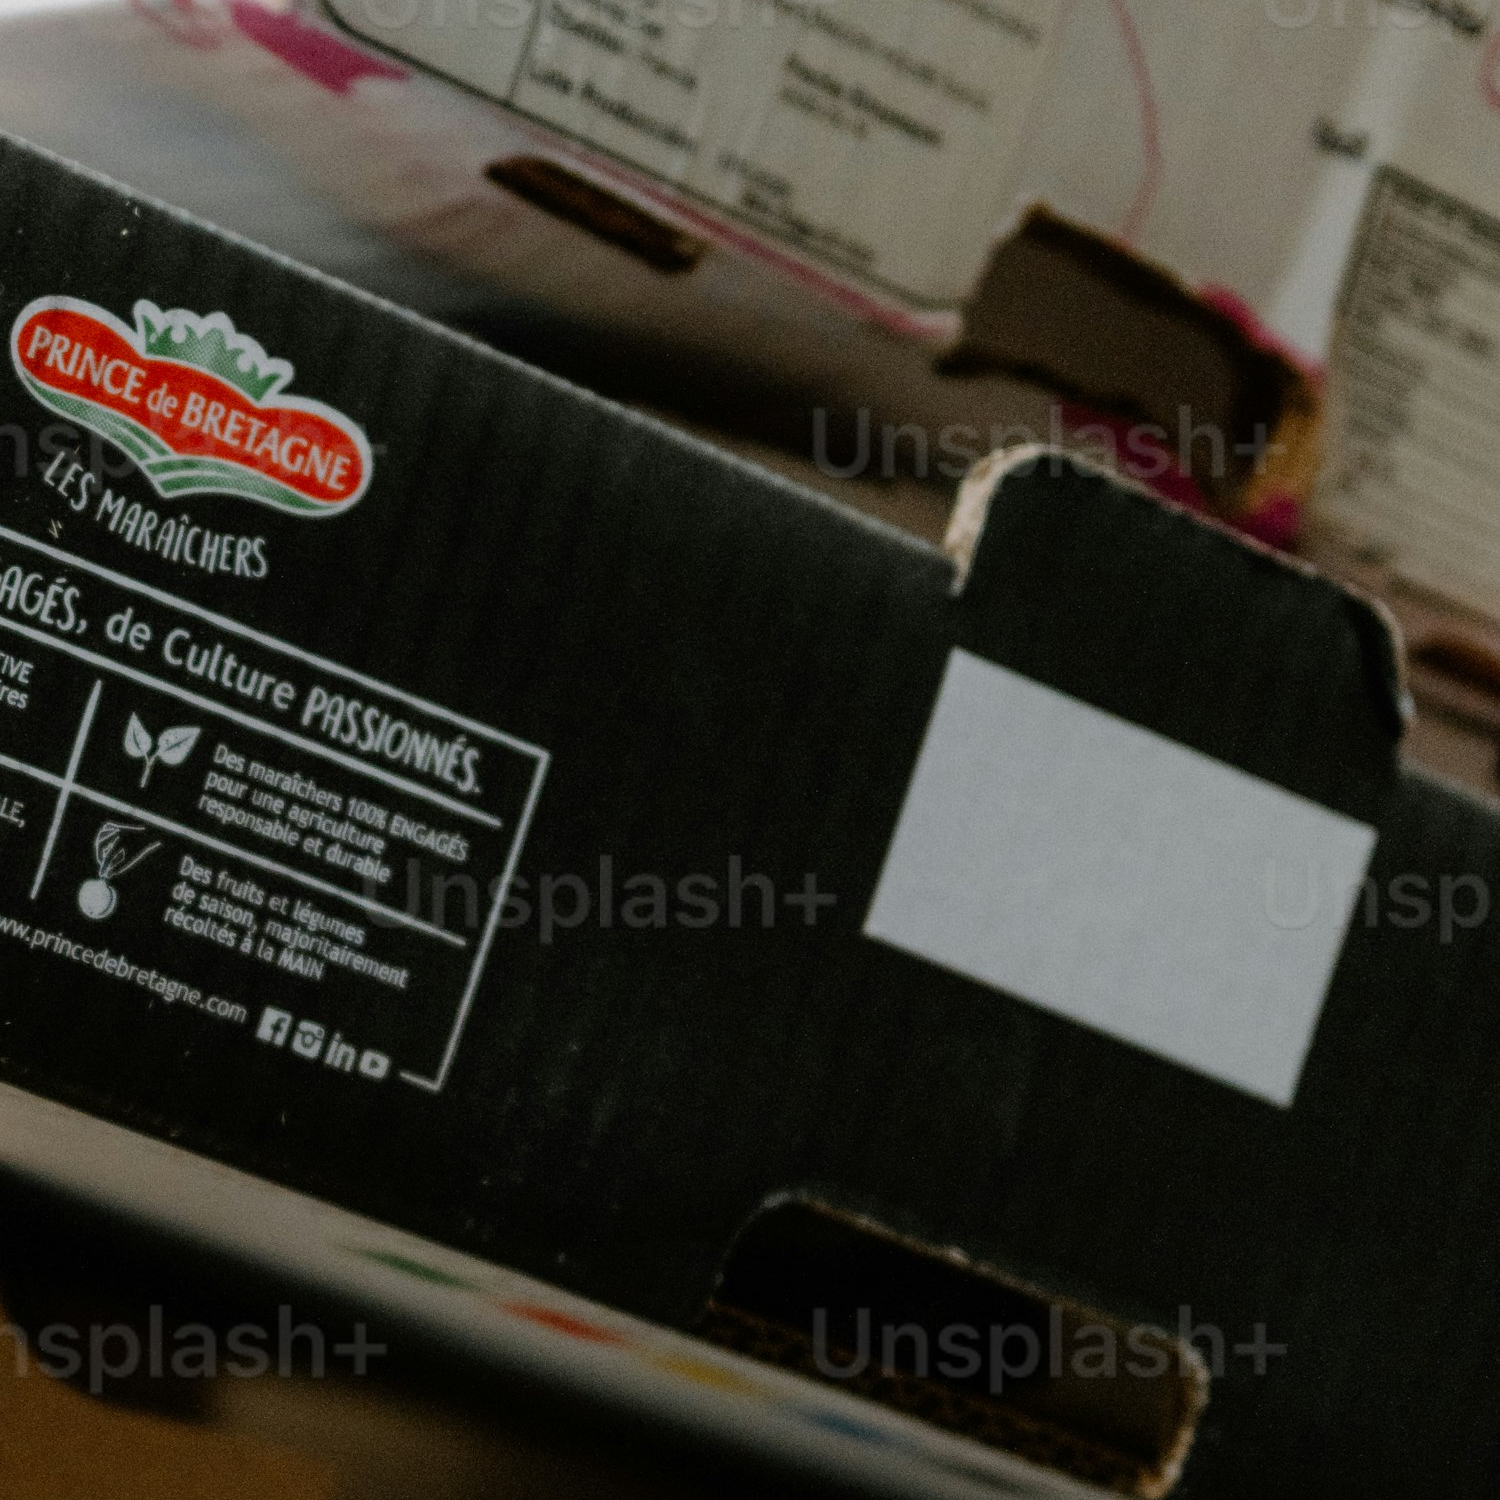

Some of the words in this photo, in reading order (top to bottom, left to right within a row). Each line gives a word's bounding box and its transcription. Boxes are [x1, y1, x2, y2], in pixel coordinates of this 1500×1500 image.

[27, 325, 146, 404] PRINCE
[145, 381, 179, 419] de
[179, 391, 353, 492] BRETAGNE
[43, 450, 97, 513] LES
[95, 488, 269, 580] MARAÎCHERS
[105, 607, 152, 651] de
[163, 628, 296, 710] Culture
[198, 794, 300, 846] responsable
[302, 837, 323, 857] et
[325, 843, 391, 883] durable
[204, 771, 249, 799] pour
[251, 791, 285, 815] une
[287, 804, 386, 855] agriculture
[213, 743, 246, 773] Des
[248, 761, 343, 812] maraîchers
[347, 798, 388, 830] 100%
[388, 814, 468, 862] ENGAGÉS
[164, 905, 237, 948] récoltés
[239, 931, 253, 954] à
[256, 938, 275, 962] la
[277, 948, 324, 979] MAIN
[172, 881, 196, 905] de
[198, 894, 258, 936] saison,
[265, 920, 409, 989] majoritairement
[179, 855, 213, 885] Des
[216, 870, 265, 906] fruits
[268, 896, 289, 915] et
[292, 900, 365, 946] légumes
